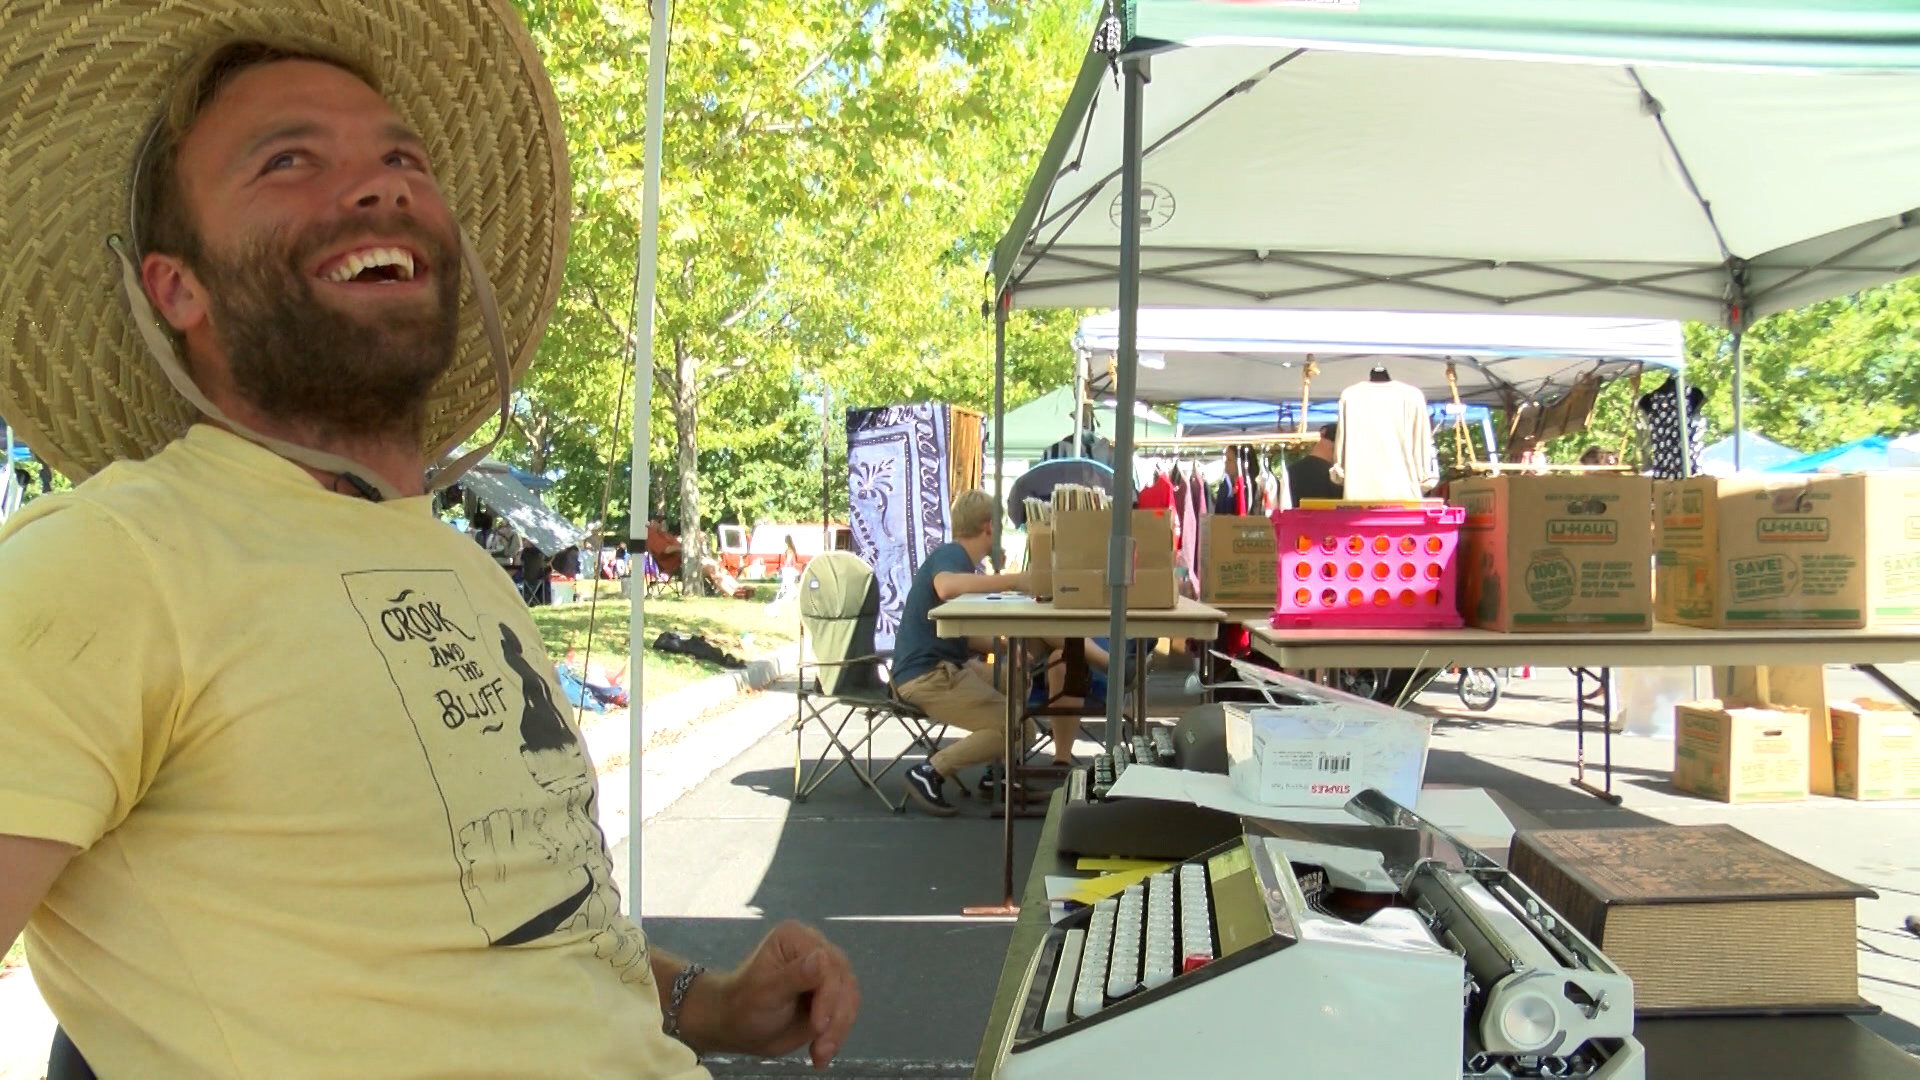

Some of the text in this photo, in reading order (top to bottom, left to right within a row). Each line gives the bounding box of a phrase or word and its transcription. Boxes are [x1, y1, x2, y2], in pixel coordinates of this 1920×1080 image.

[1550, 523, 1613, 534] U-HAUL
[1761, 521, 1824, 533] U-HAUL
[1734, 556, 1783, 576] SAVE!
[381, 601, 475, 642] CROOK
[429, 643, 465, 668] AND
[449, 660, 484, 682] THE
[434, 678, 507, 729] BLUFF
[1311, 784, 1351, 794] STAPLES
